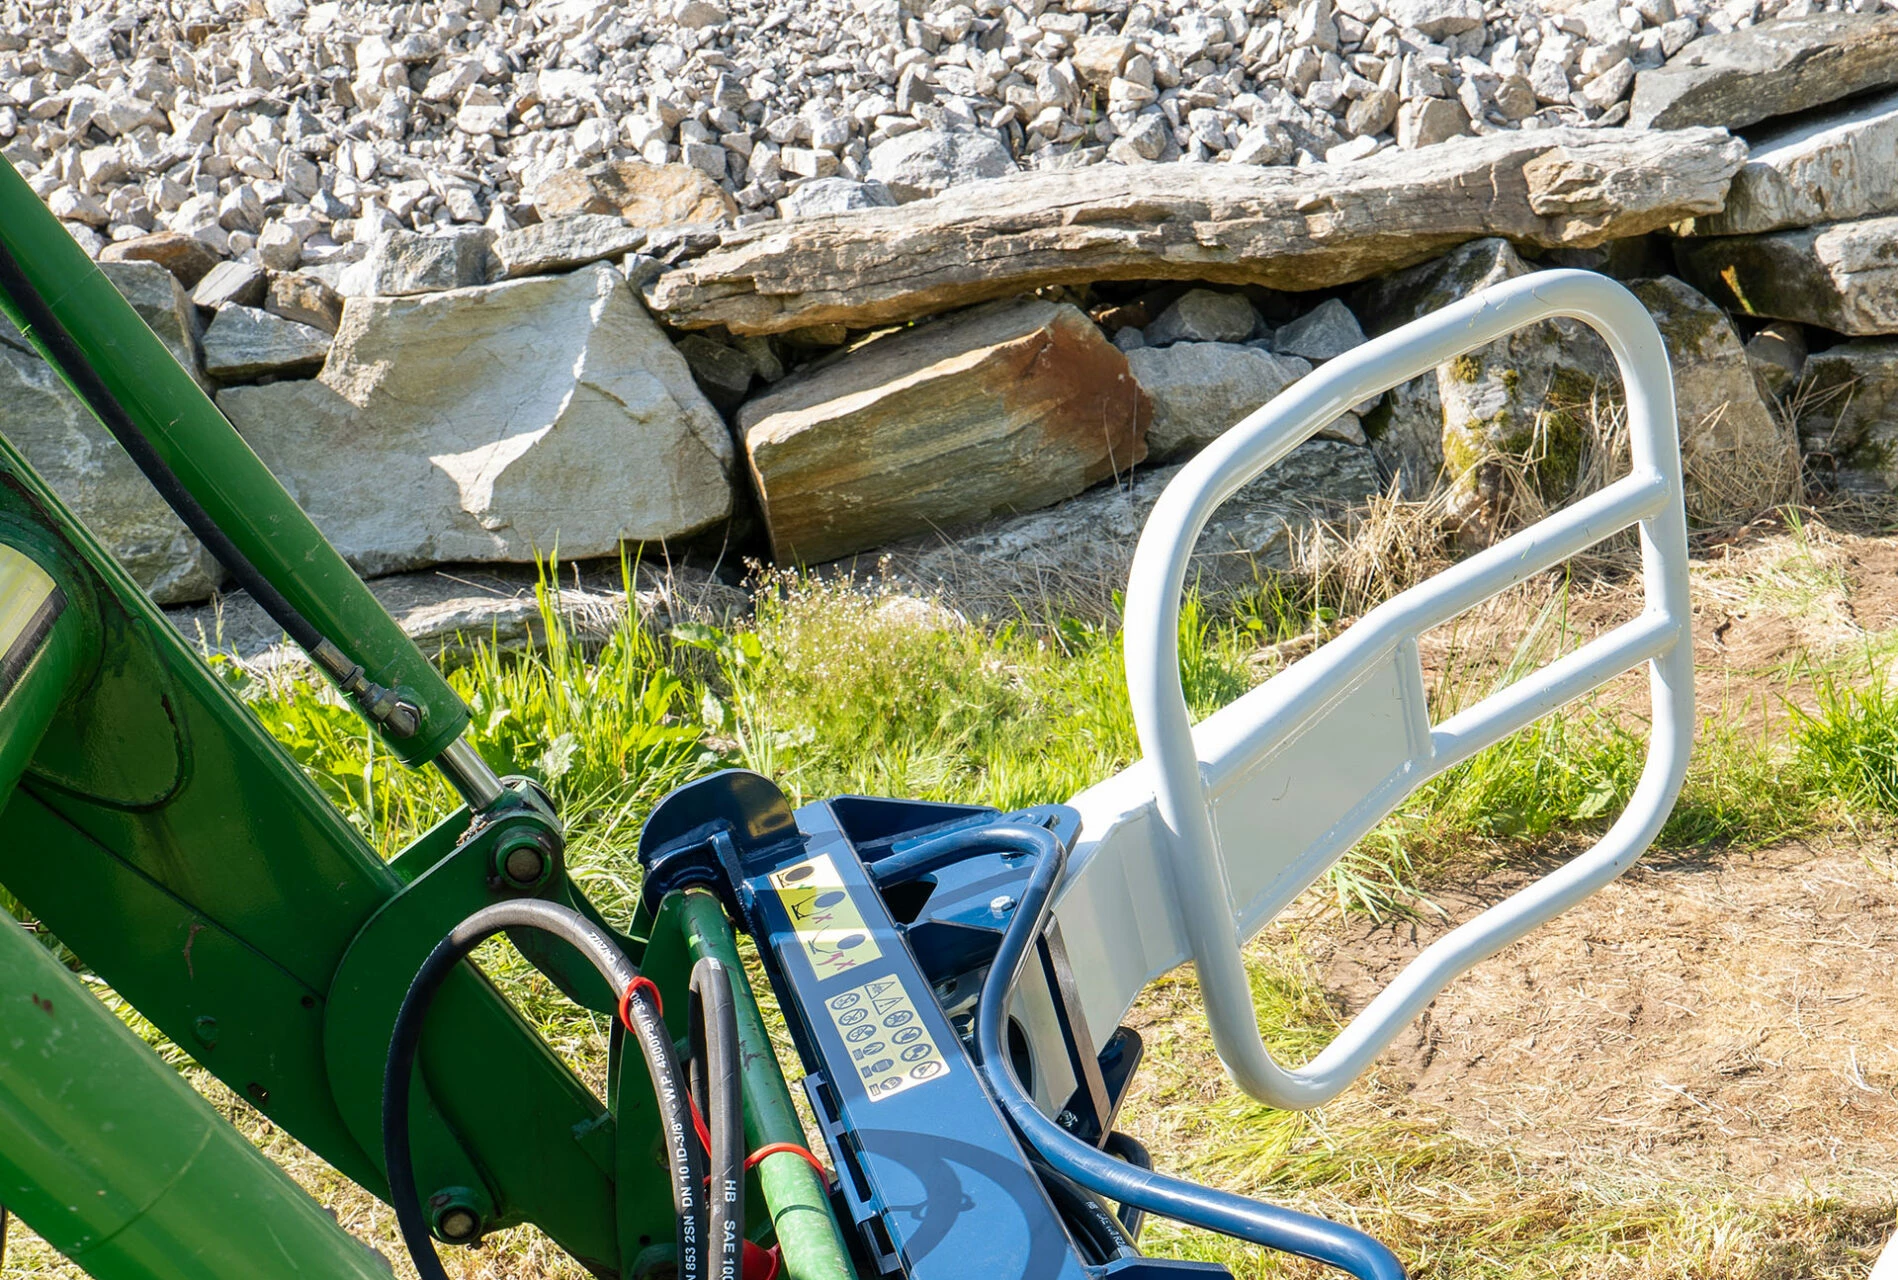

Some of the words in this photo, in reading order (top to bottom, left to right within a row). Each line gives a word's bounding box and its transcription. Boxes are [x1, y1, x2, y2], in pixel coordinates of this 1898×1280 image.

[679, 1166, 690, 1182] 10
[681, 1186, 693, 1208] DN
[725, 1180, 736, 1203] HB
[683, 1215, 696, 1243] 2SN
[723, 1220, 736, 1253] SAE
[685, 1247, 696, 1270] 853
